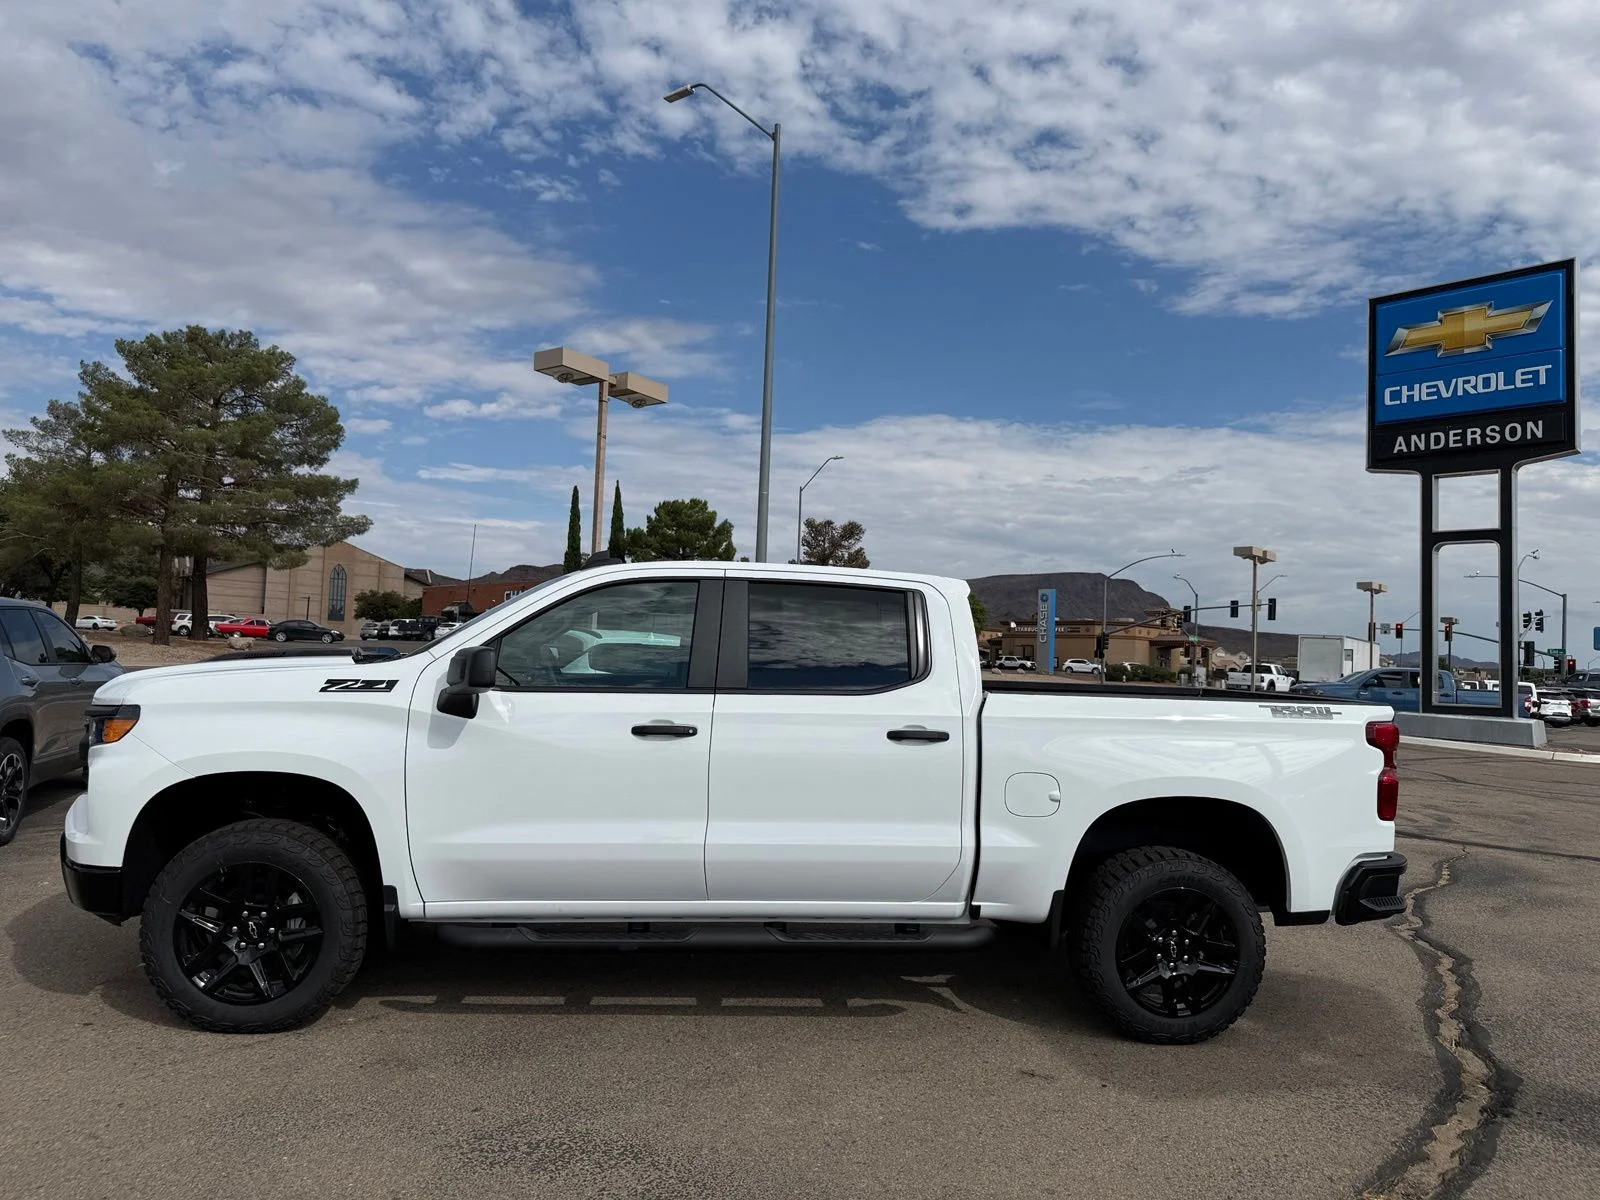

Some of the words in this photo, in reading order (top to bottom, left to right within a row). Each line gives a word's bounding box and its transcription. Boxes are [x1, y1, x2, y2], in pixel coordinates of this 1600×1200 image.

[1384, 365, 1552, 406] CHEVROLET
[1393, 420, 1543, 454] ANDERSON
[1040, 603, 1048, 643] CHASE
[319, 678, 399, 693] Z71
